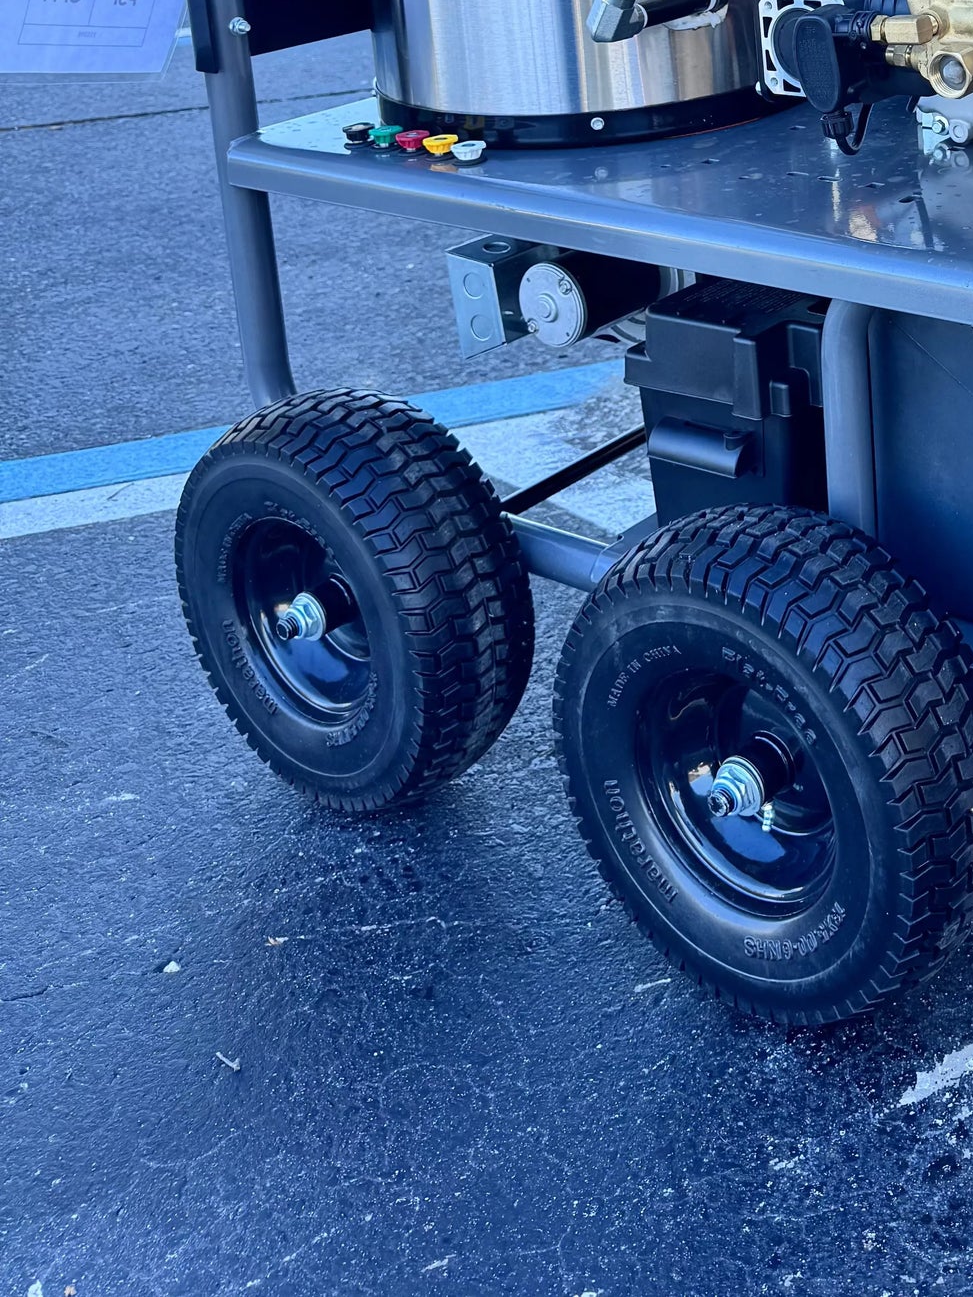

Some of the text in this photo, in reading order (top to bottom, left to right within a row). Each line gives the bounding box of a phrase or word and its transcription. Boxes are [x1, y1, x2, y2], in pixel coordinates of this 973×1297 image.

[222, 618, 279, 715] marathon
[607, 644, 683, 708] MADE IN CHINA
[603, 779, 679, 904] marathon
